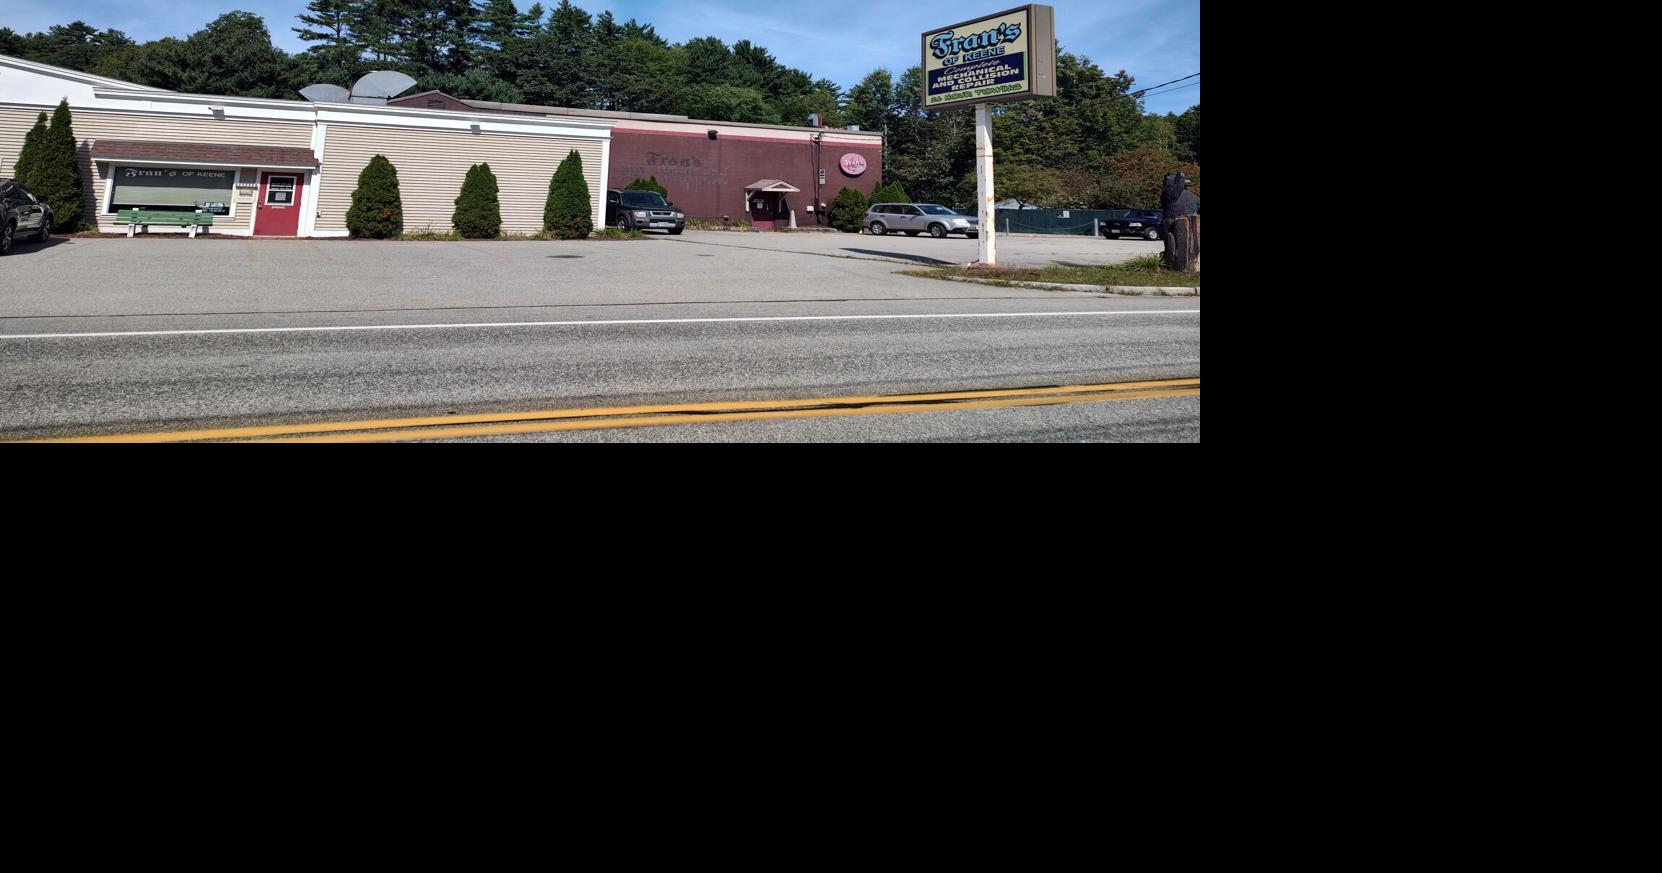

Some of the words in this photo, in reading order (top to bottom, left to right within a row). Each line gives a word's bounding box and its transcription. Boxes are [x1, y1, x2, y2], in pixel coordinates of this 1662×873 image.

[930, 22, 1021, 59] Fran's
[943, 56, 959, 66] OF
[963, 46, 1005, 62] KEENE
[938, 64, 1011, 82] MECHANICAL
[944, 59, 1000, 75] Complete
[932, 79, 955, 89] AND
[957, 68, 1019, 84] COLLISION
[951, 78, 995, 91] REPAIR
[944, 90, 973, 101] HOUR
[974, 83, 1022, 97] TOWING
[125, 168, 177, 178] Fran's
